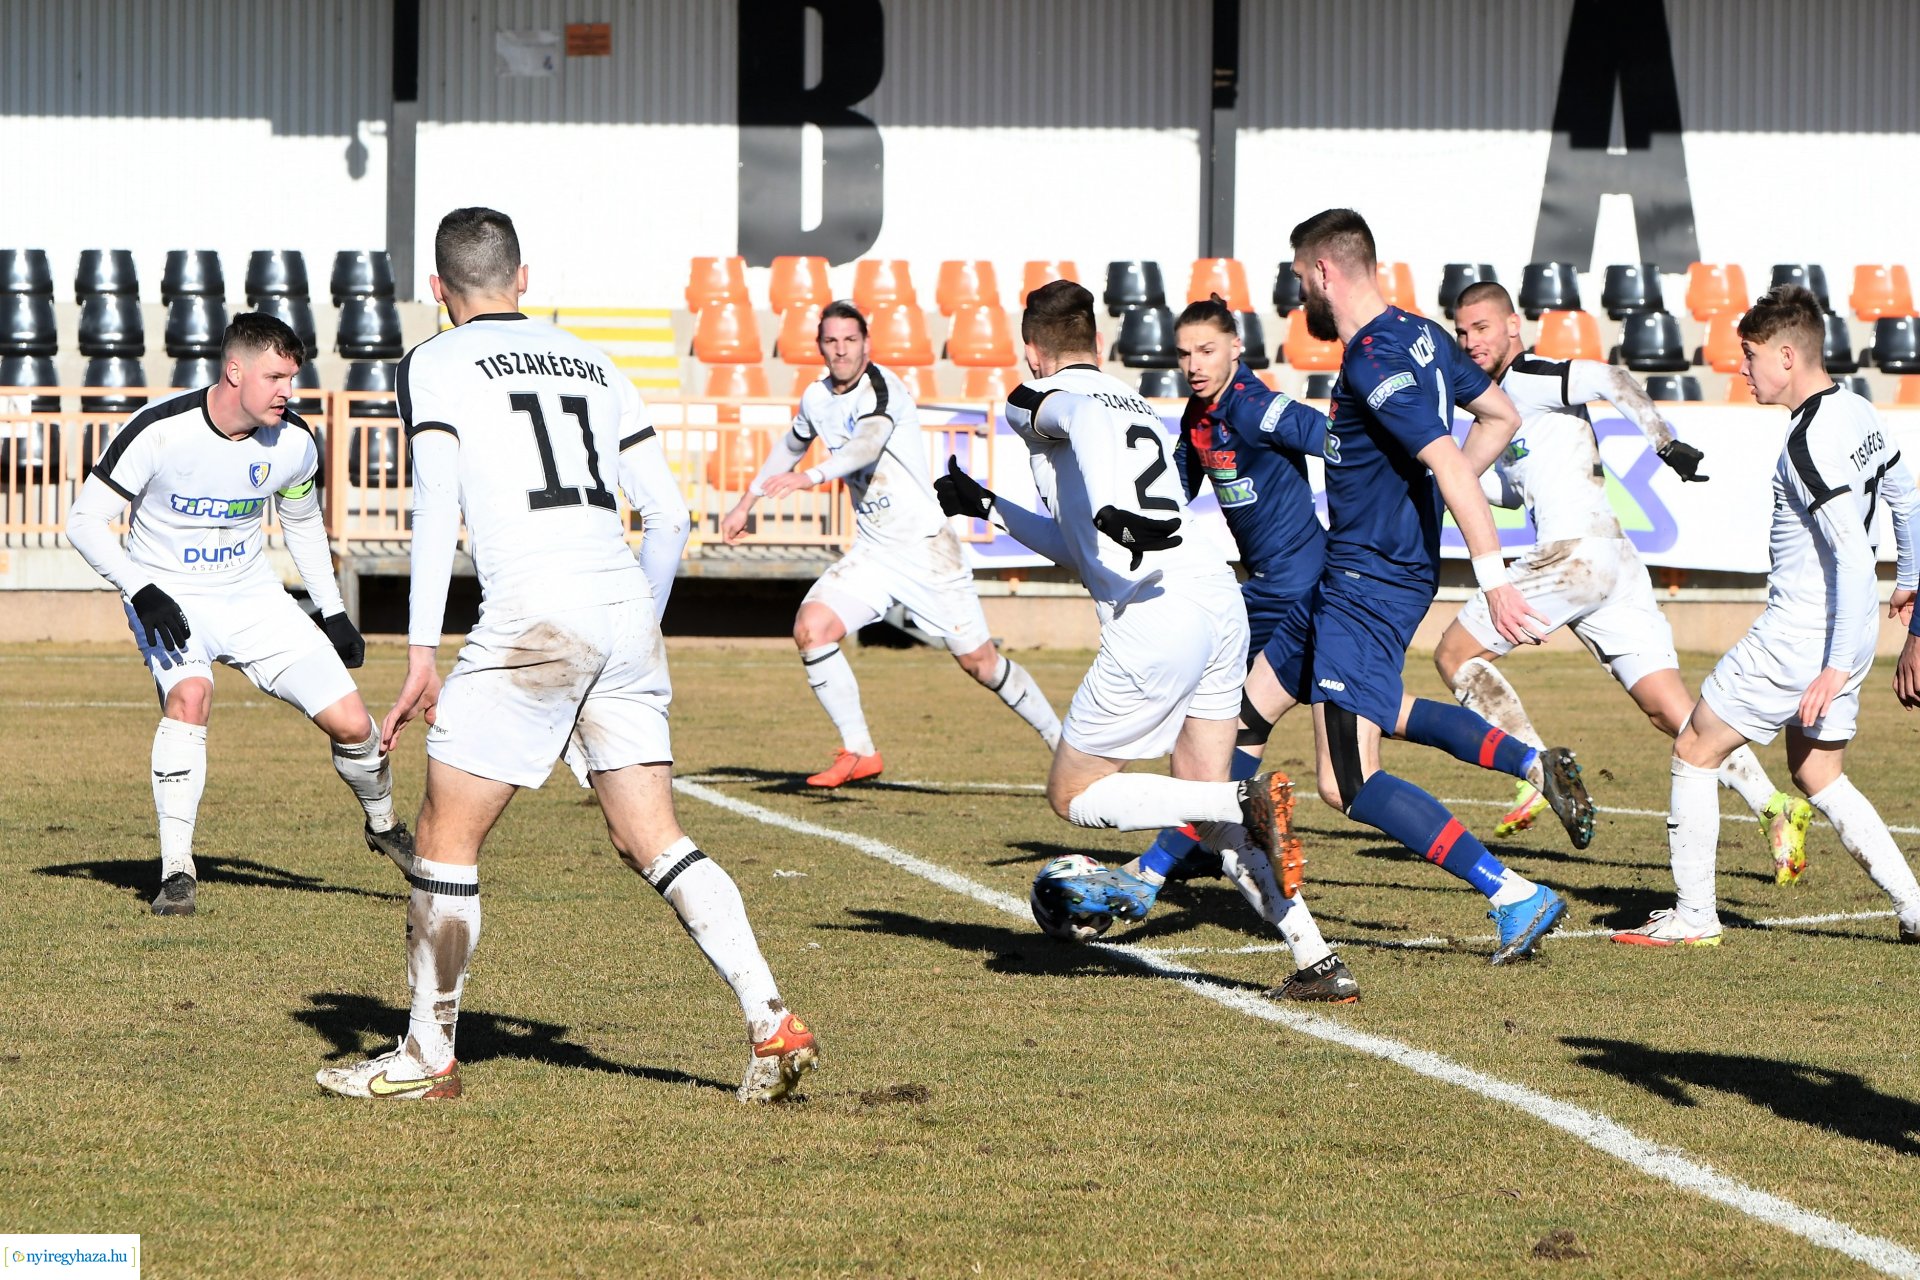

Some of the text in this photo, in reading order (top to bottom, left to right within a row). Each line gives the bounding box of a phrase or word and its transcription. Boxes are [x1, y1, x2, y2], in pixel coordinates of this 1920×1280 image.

[737, 0, 1701, 274] B A
[475, 351, 608, 387] TISZAKÉCSKE
[507, 391, 617, 513] 11
[1126, 423, 1180, 512] 2
[1318, 679, 1345, 691] JAKO
